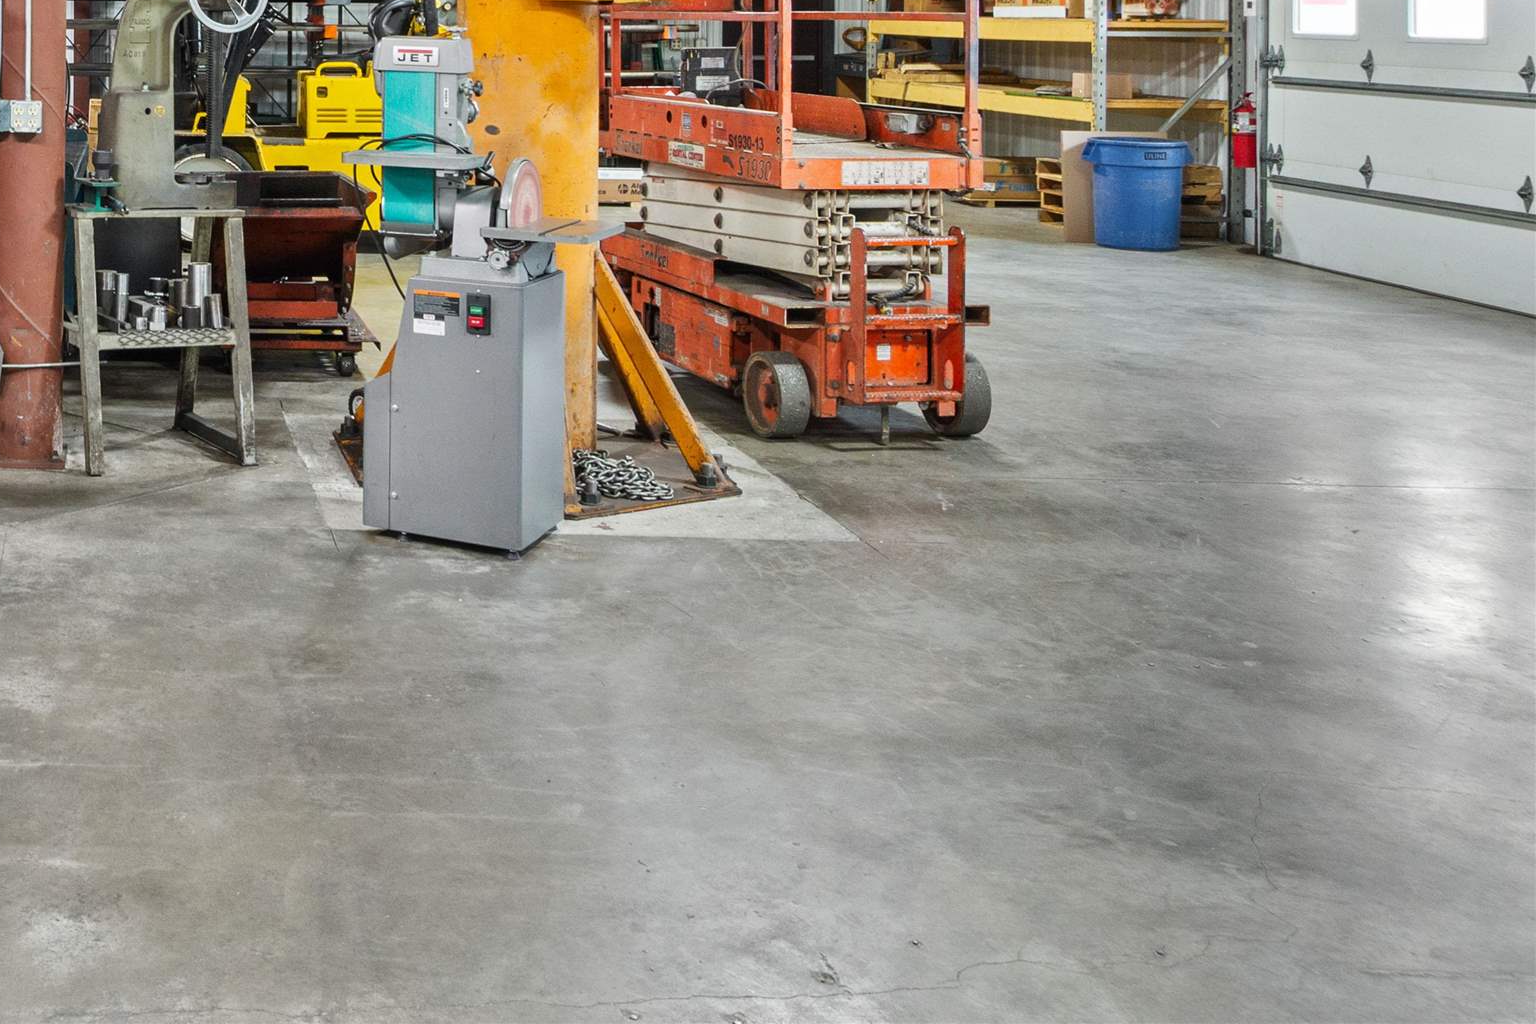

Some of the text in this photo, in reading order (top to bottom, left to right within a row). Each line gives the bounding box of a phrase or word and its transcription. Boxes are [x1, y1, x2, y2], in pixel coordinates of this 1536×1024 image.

[397, 53, 433, 64] JET
[728, 134, 765, 152] S1930-13
[737, 155, 772, 181] S1930
